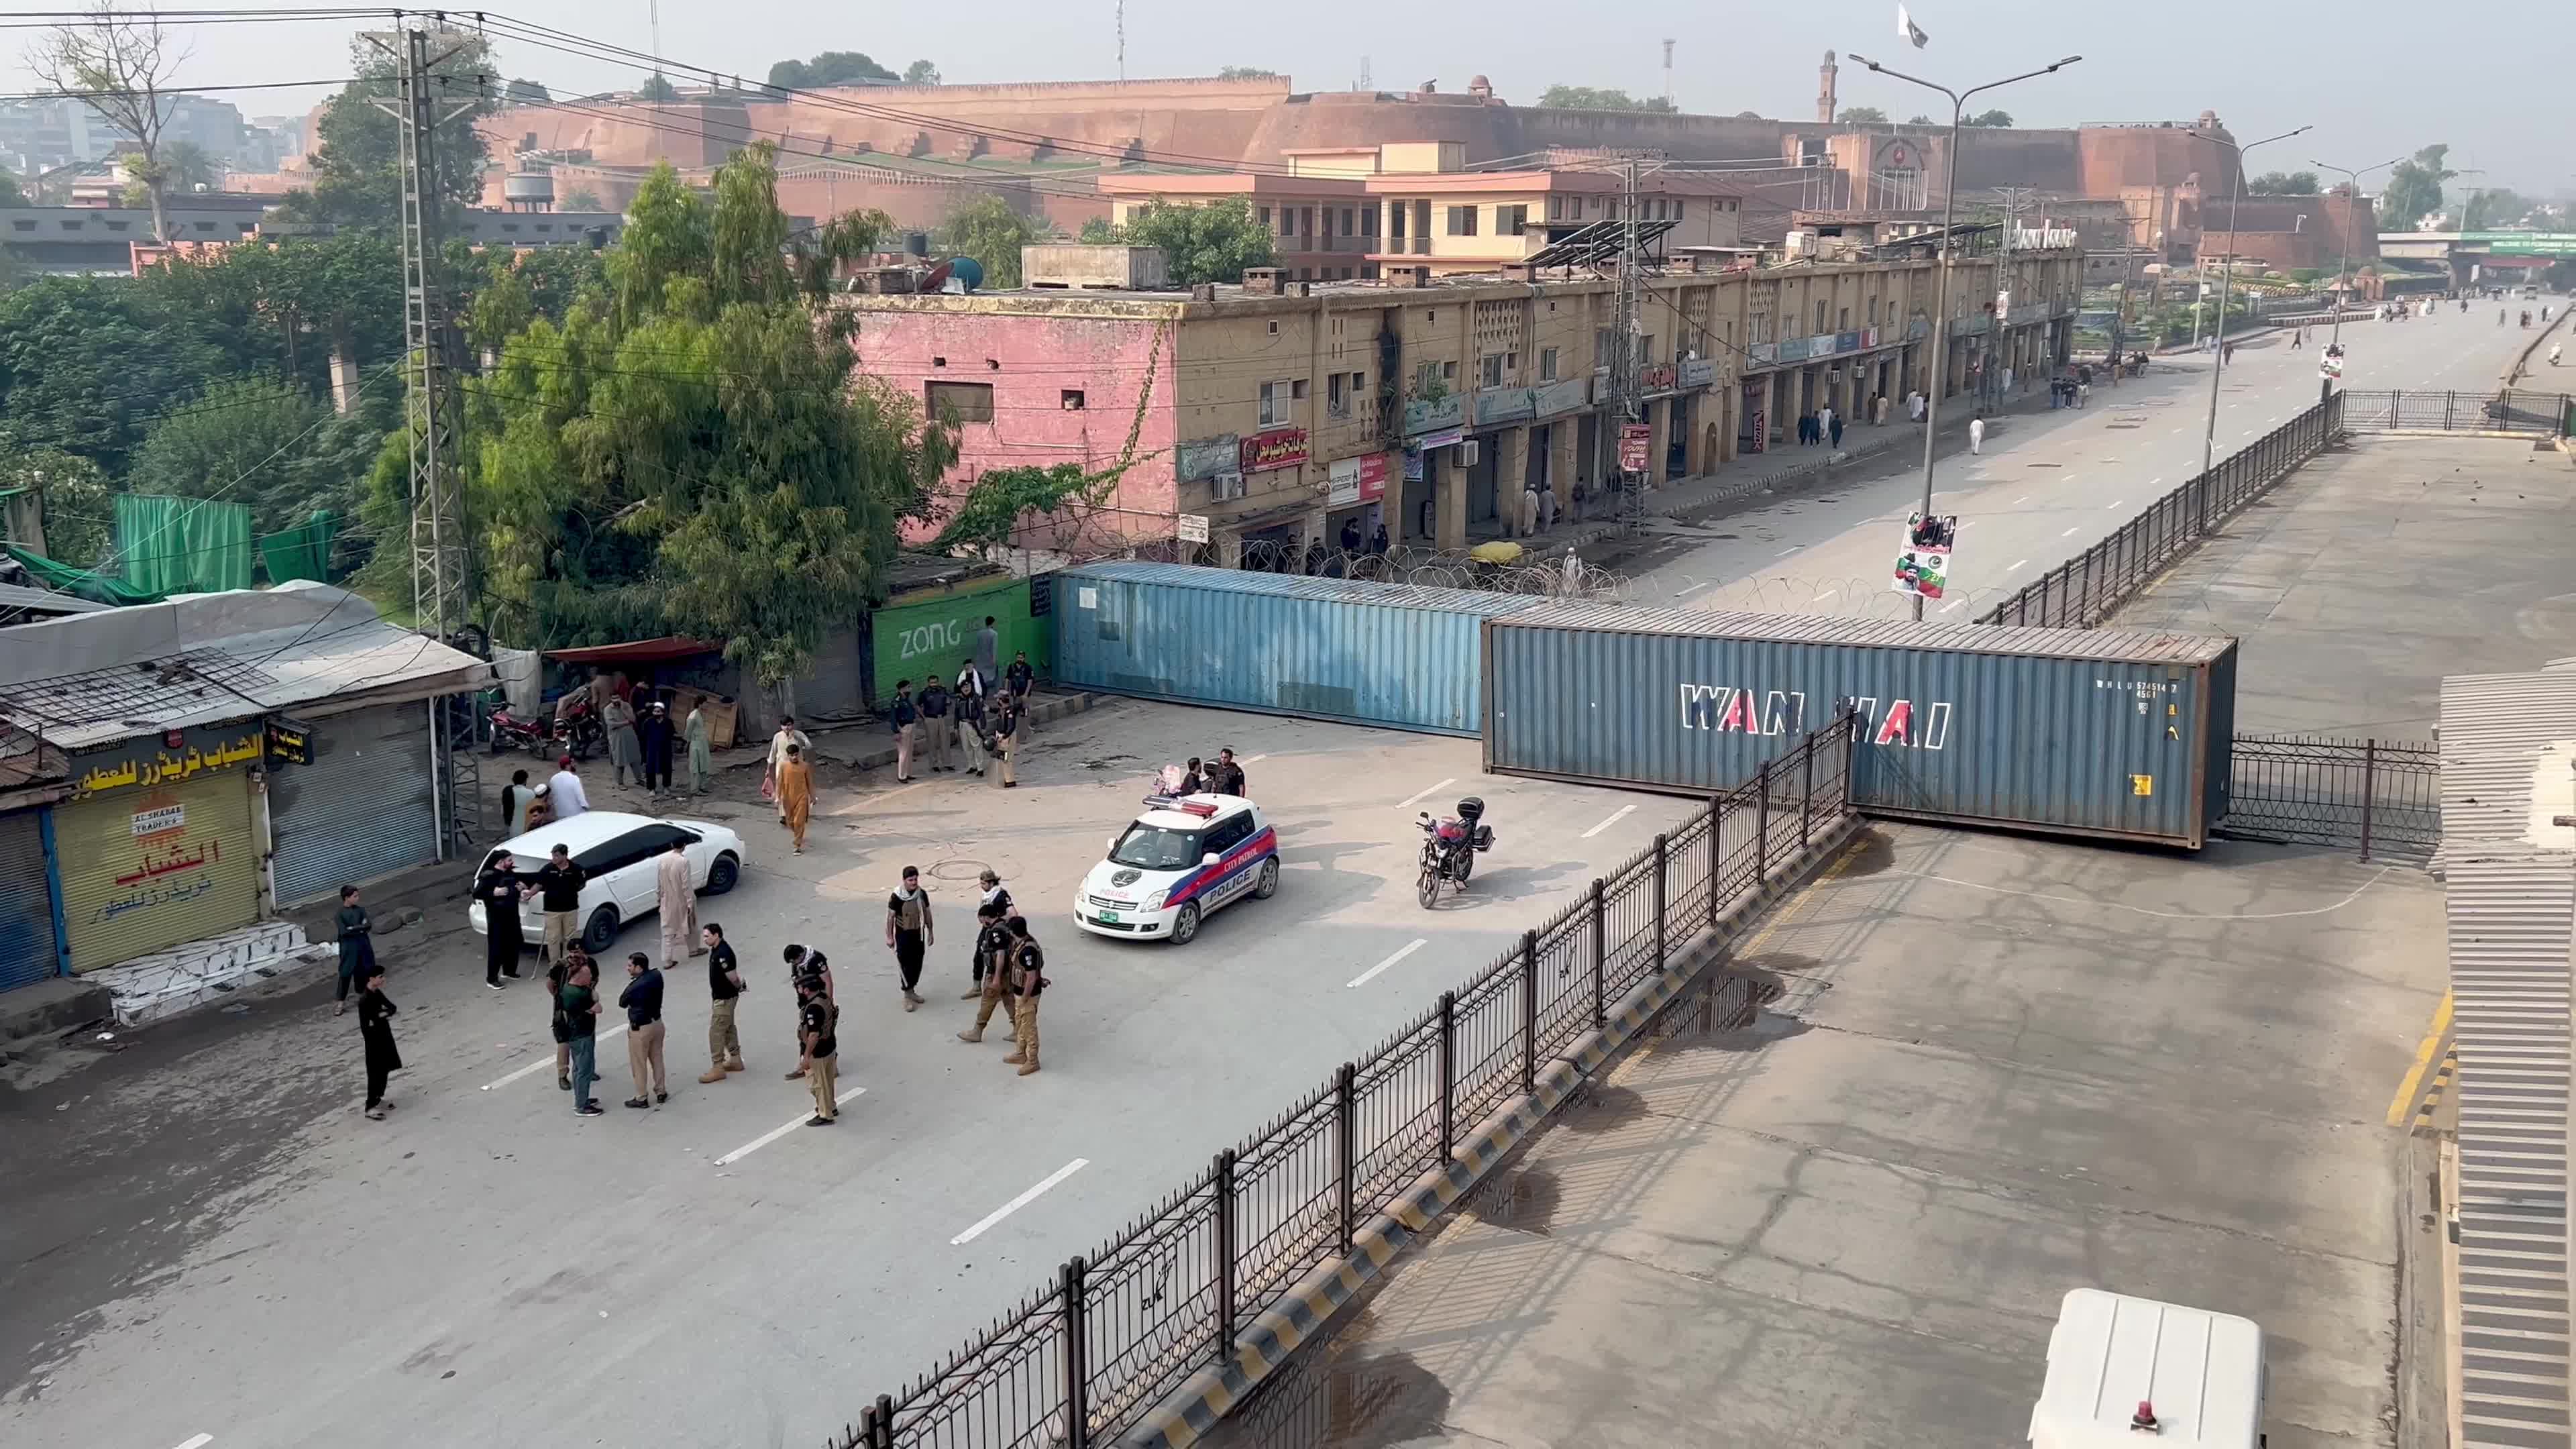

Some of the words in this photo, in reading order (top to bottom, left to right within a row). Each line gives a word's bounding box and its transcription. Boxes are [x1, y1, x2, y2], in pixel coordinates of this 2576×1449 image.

[2137, 682, 2166, 692] 574514
[1680, 684, 1805, 736] WAN
[1830, 695, 1951, 750] HAI
[141, 745, 201, 786] ٹریڈرز
[204, 732, 264, 771] الشباب
[135, 814, 147, 822] AL
[136, 816, 176, 833] TRADERS
[114, 839, 219, 888] الشباب
[1224, 859, 1240, 872] CITY
[1239, 847, 1258, 865] PATROL
[1100, 888, 1129, 900] POLICE
[1210, 869, 1251, 902] POLICE
